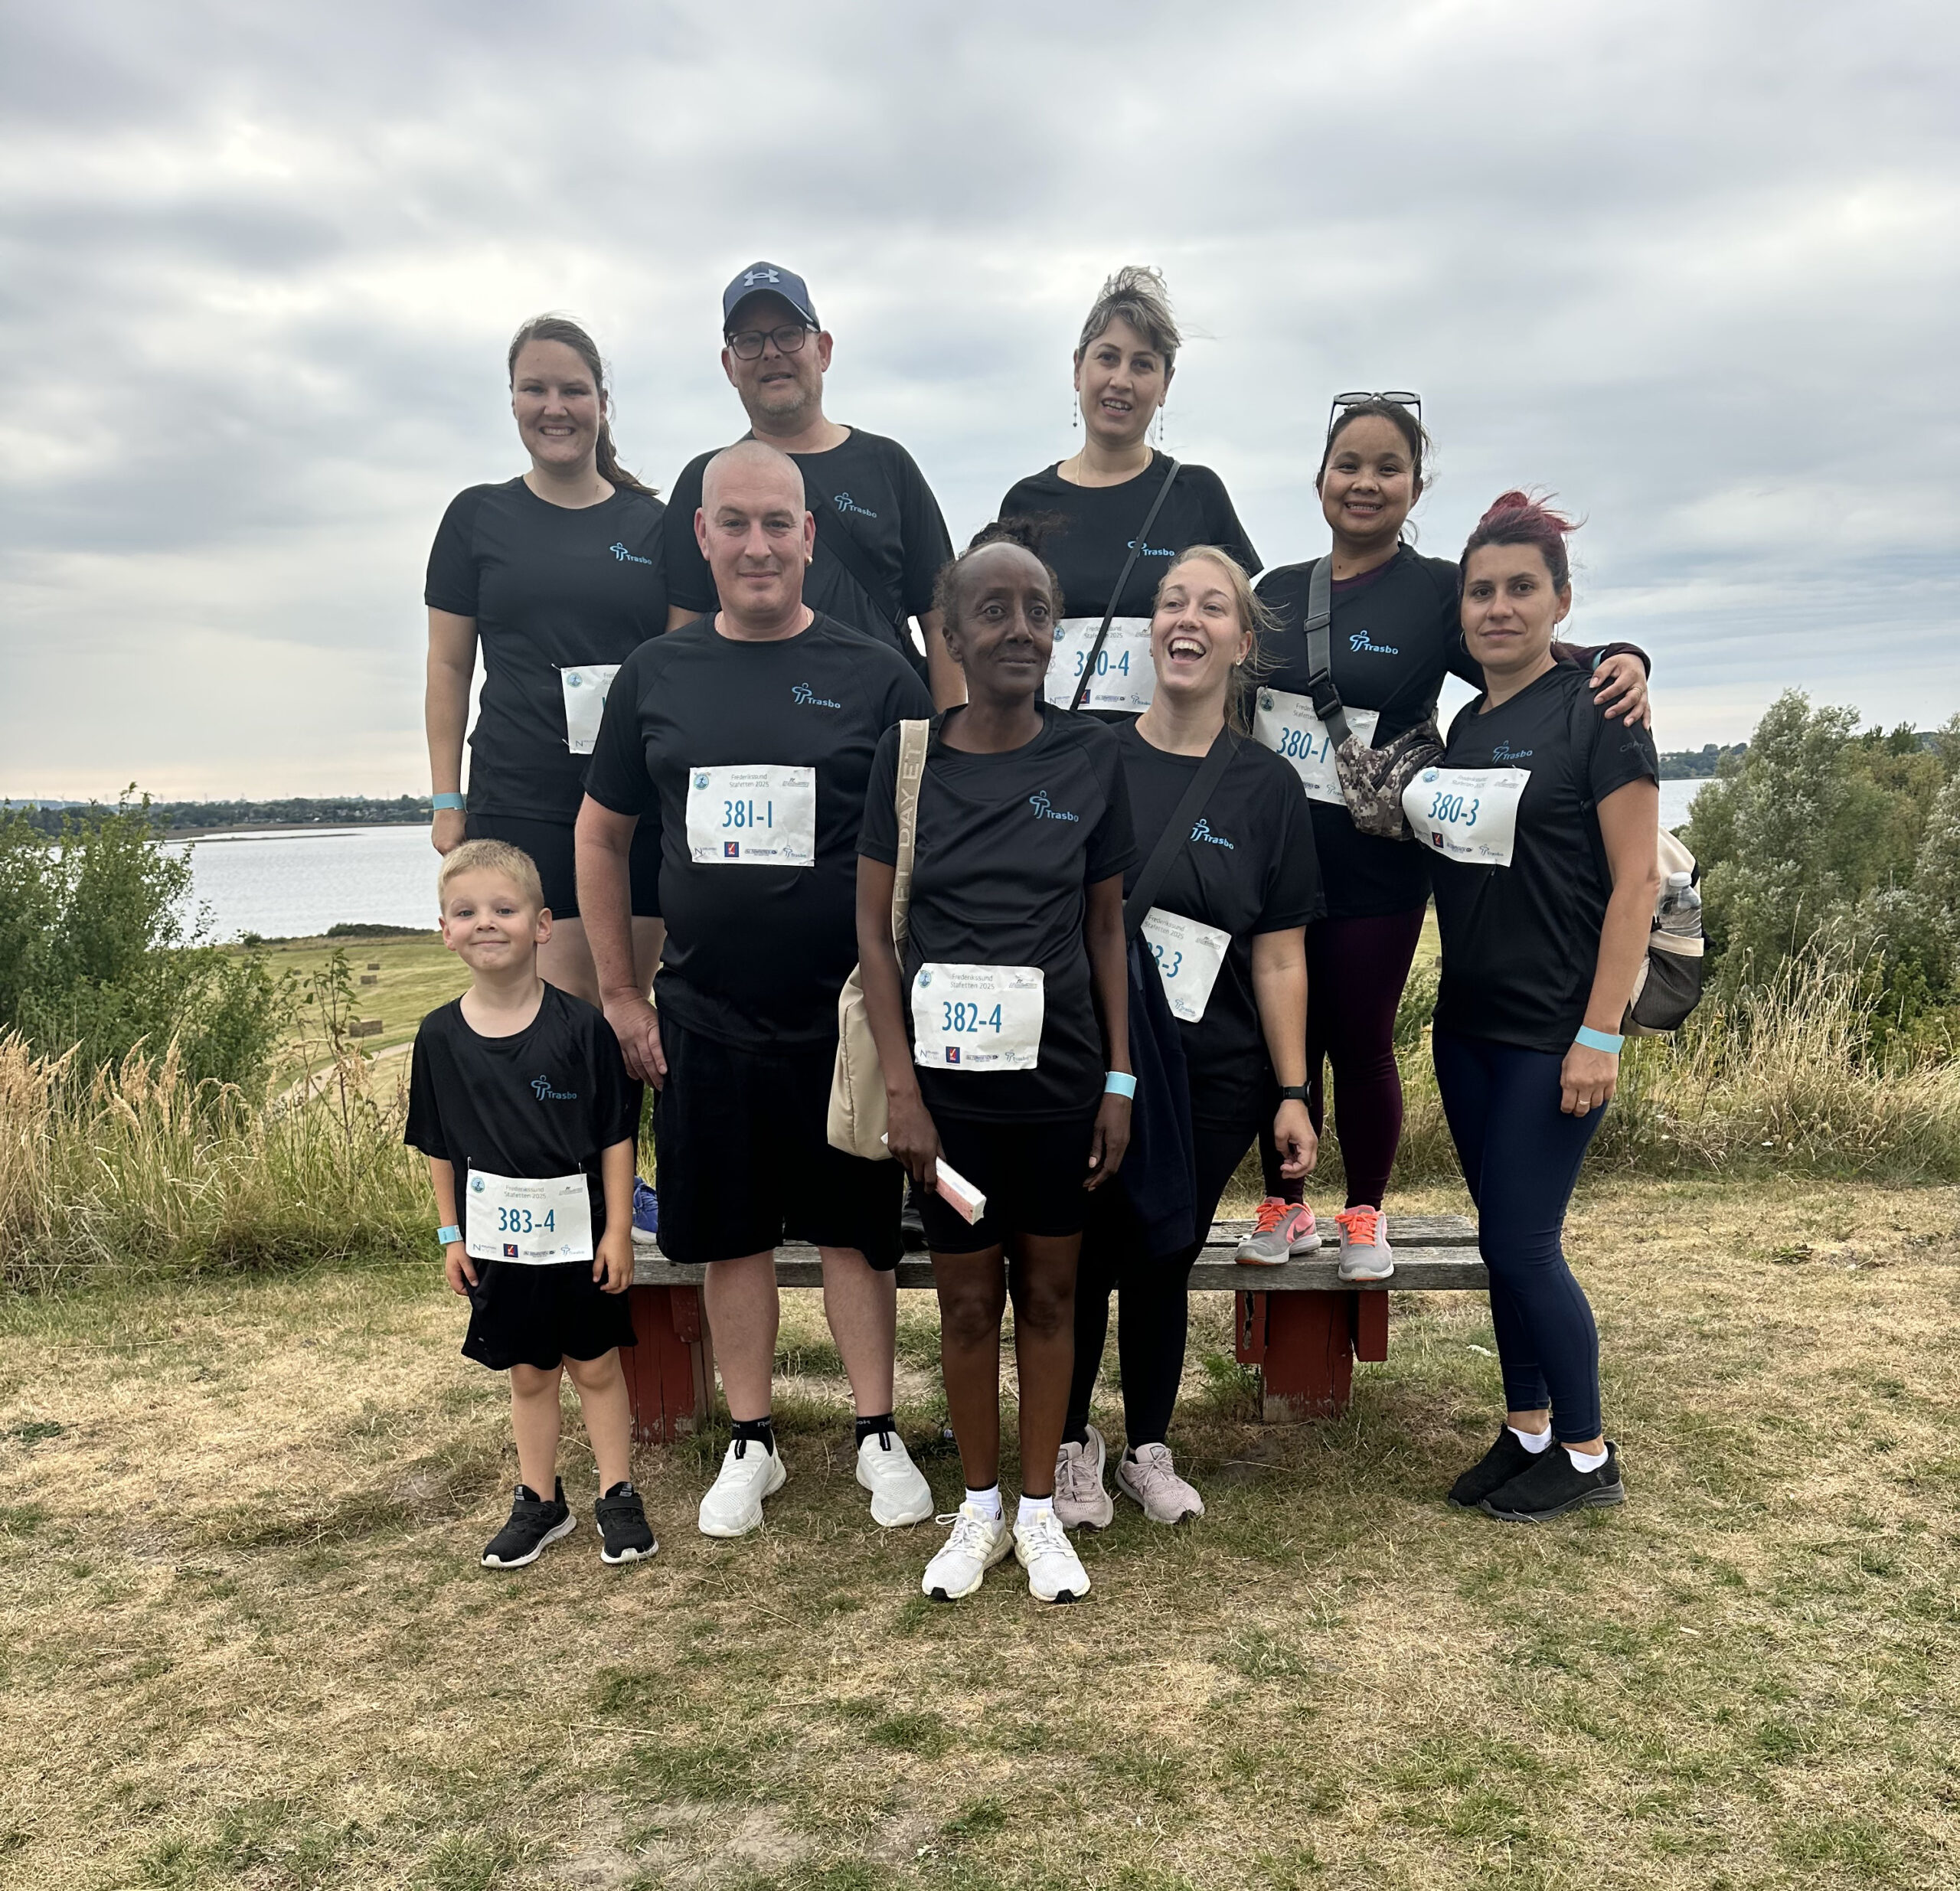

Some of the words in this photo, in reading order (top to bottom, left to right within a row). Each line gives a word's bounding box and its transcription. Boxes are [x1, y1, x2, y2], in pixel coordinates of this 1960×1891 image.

[848, 505, 877, 518] Trasbo
[1142, 547, 1175, 557] Trasbo
[626, 554, 652, 565] Trasbo
[1364, 643, 1399, 655] Trasbo
[806, 697, 841, 709] Trasbo
[1276, 727, 1330, 764] 380-1
[1502, 749, 1534, 760] Trasbo
[722, 799, 773, 828] 381-1
[1428, 792, 1480, 826] 380-3
[898, 788, 915, 848] DAY
[1046, 809, 1080, 823] Trasbo
[1204, 834, 1234, 850] Trasbo
[1170, 930, 1184, 940] 2025
[952, 973, 993, 981] Frederikssund
[942, 1001, 1002, 1034] 382-4
[547, 1091, 577, 1099] Trasbo
[498, 1207, 556, 1233] 383-4
